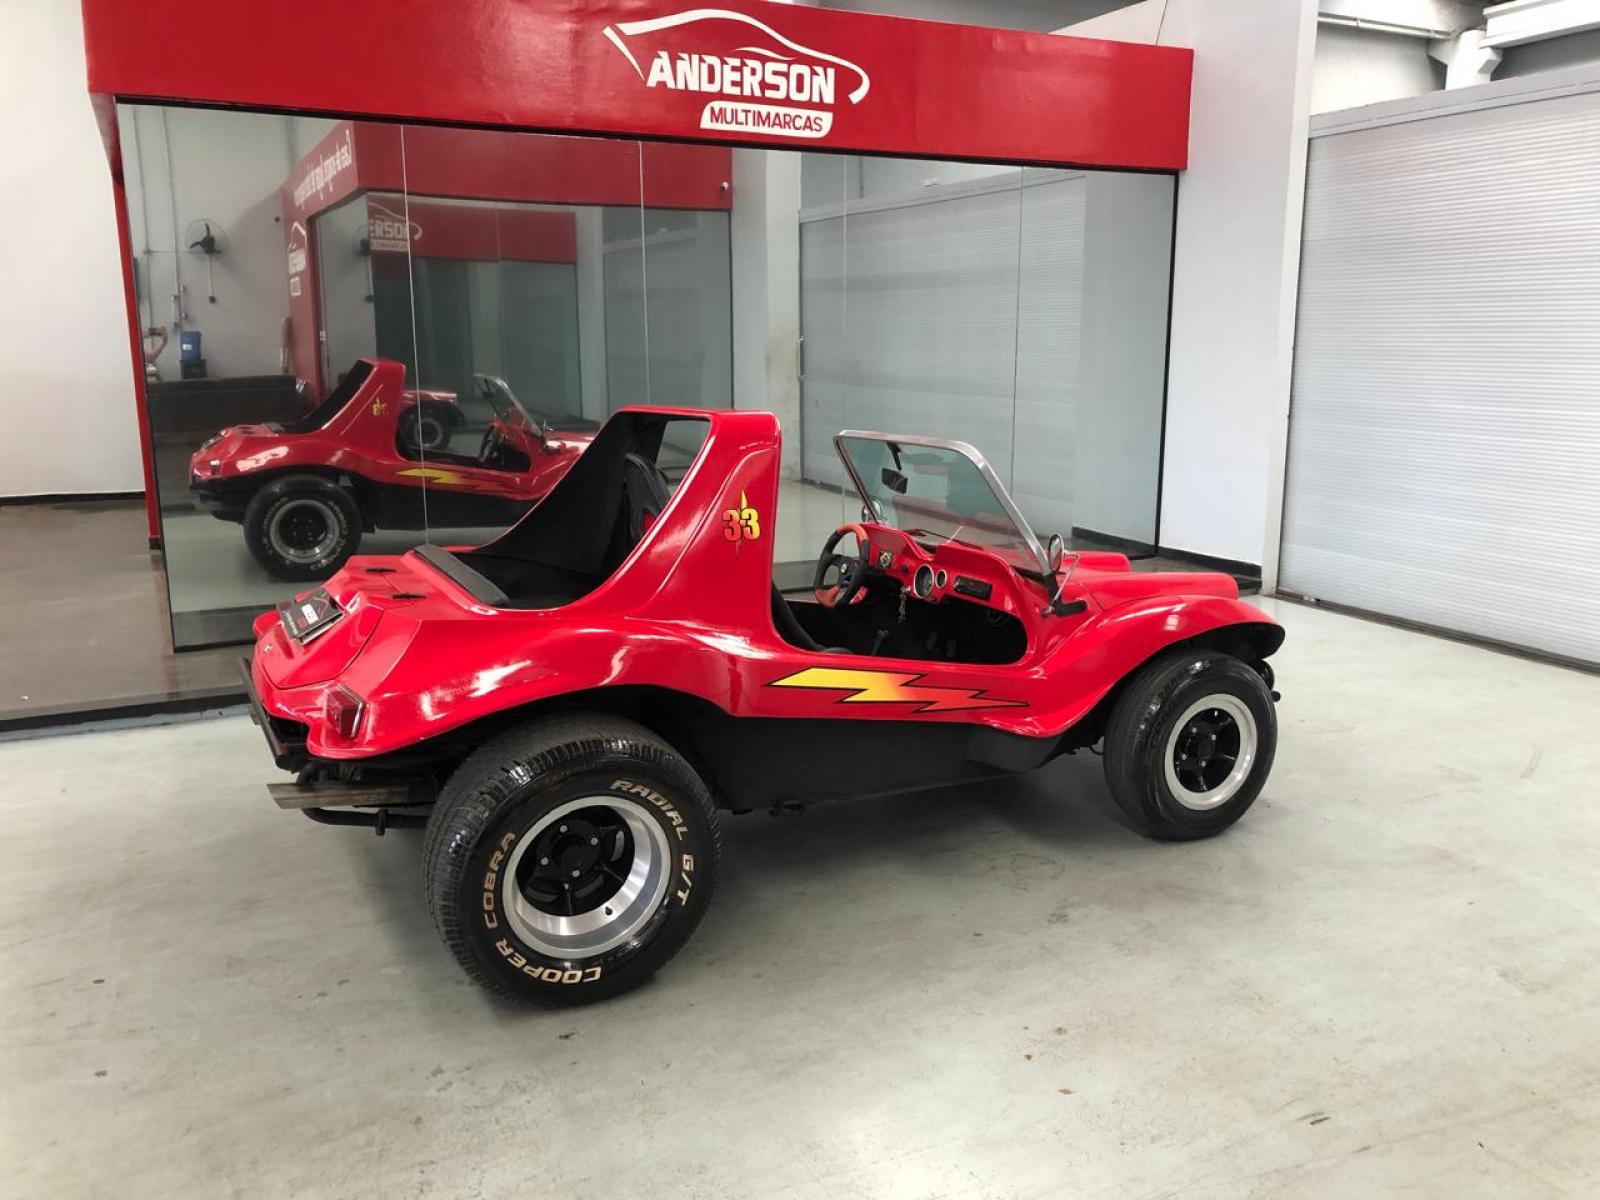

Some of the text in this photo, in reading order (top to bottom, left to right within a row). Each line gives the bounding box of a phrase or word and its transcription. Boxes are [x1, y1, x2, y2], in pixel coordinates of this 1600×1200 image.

[646, 51, 835, 104] ANDERSON
[709, 106, 823, 132] MULTIMARCAS
[721, 508, 760, 541] 33
[610, 779, 695, 907] RADIAL G/T
[483, 832, 601, 985] COOPER COBRA
